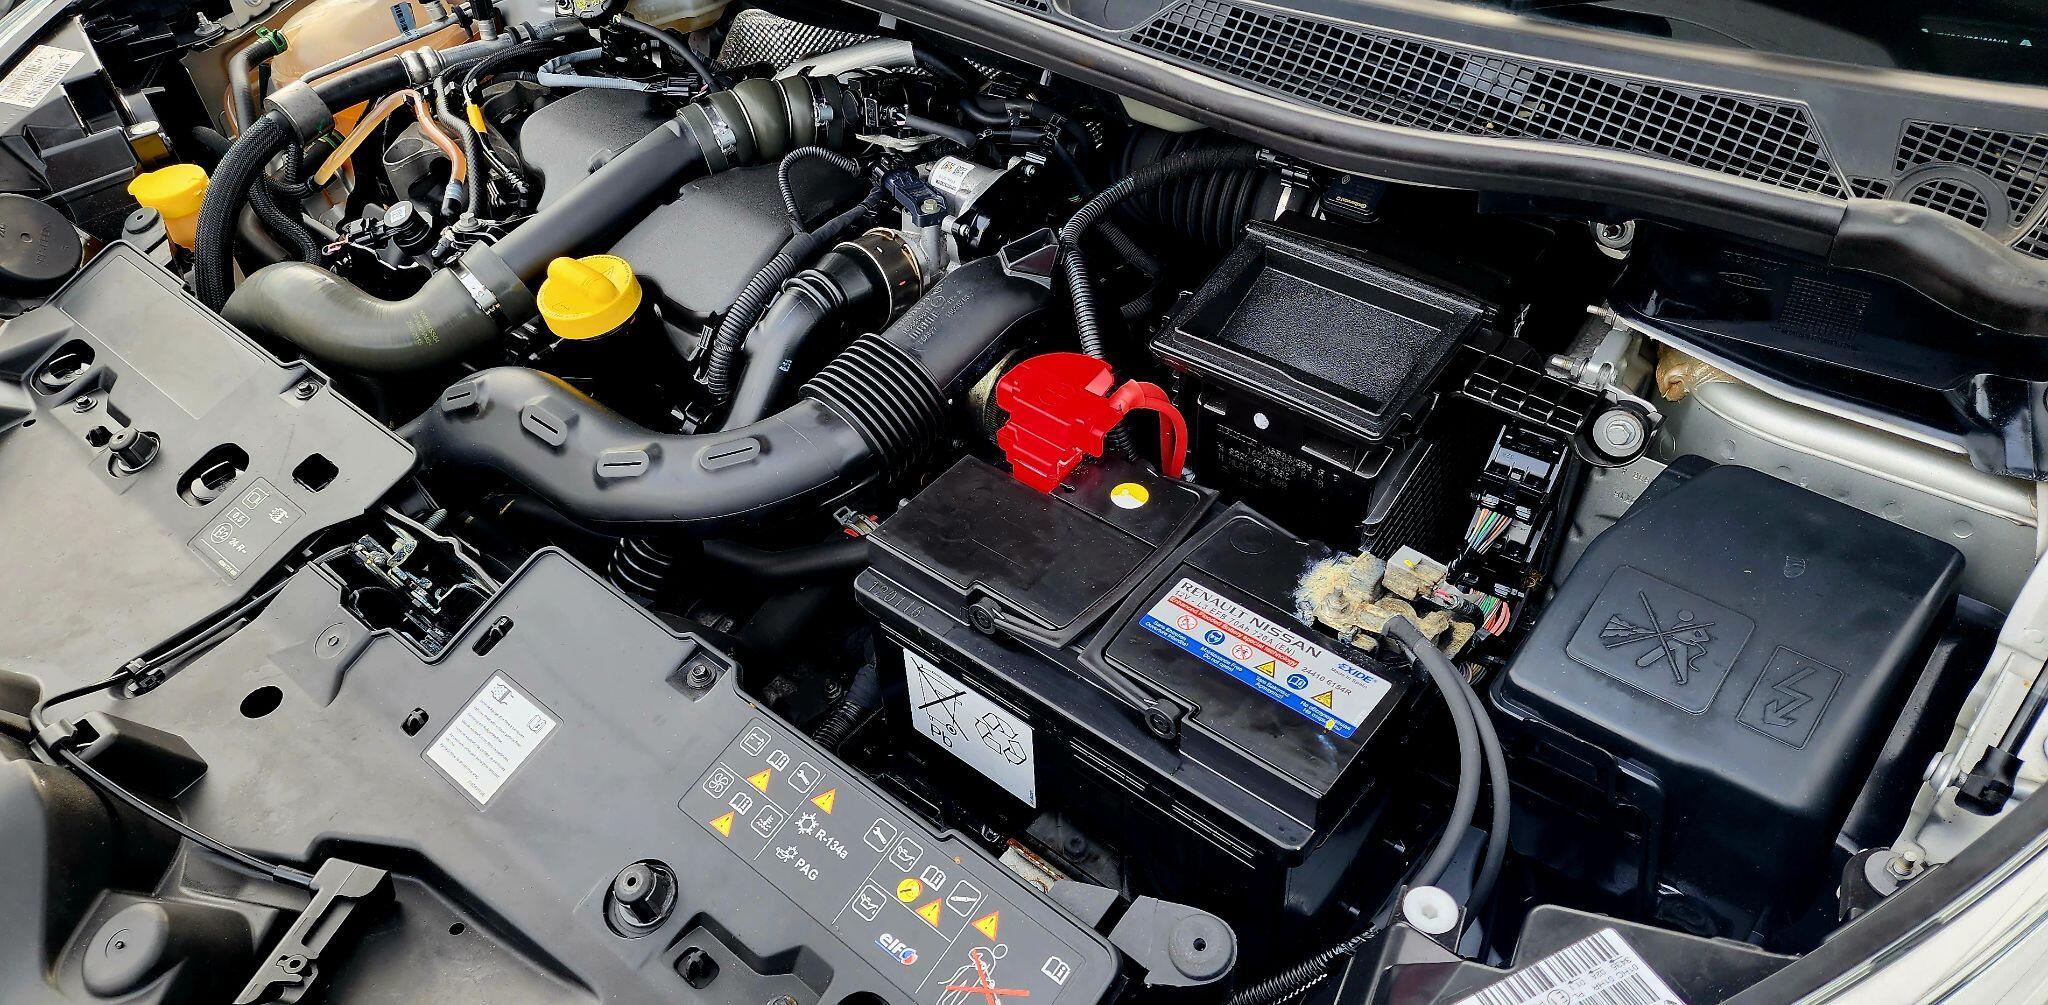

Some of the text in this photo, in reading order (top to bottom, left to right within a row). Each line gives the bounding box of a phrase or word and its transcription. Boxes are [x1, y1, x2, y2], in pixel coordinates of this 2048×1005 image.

[232, 512, 243, 522] 0,5
[1171, 597, 1296, 667] Enhanced Flooded Battery special technology
[1175, 591, 1190, 600] 12V
[1196, 601, 1208, 609] L3
[1208, 608, 1227, 620] EFB
[1227, 617, 1251, 632] 70Ah
[1251, 630, 1274, 645] 720A
[1274, 641, 1296, 656] (EN)
[1181, 582, 1322, 658] RENAULT NISSAN
[1302, 667, 1325, 681] 24410
[1338, 663, 1373, 683] EXIDE
[930, 723, 952, 748] Pb
[815, 828, 848, 859] R-134a
[794, 858, 819, 881] PAG
[879, 933, 907, 956] elf
